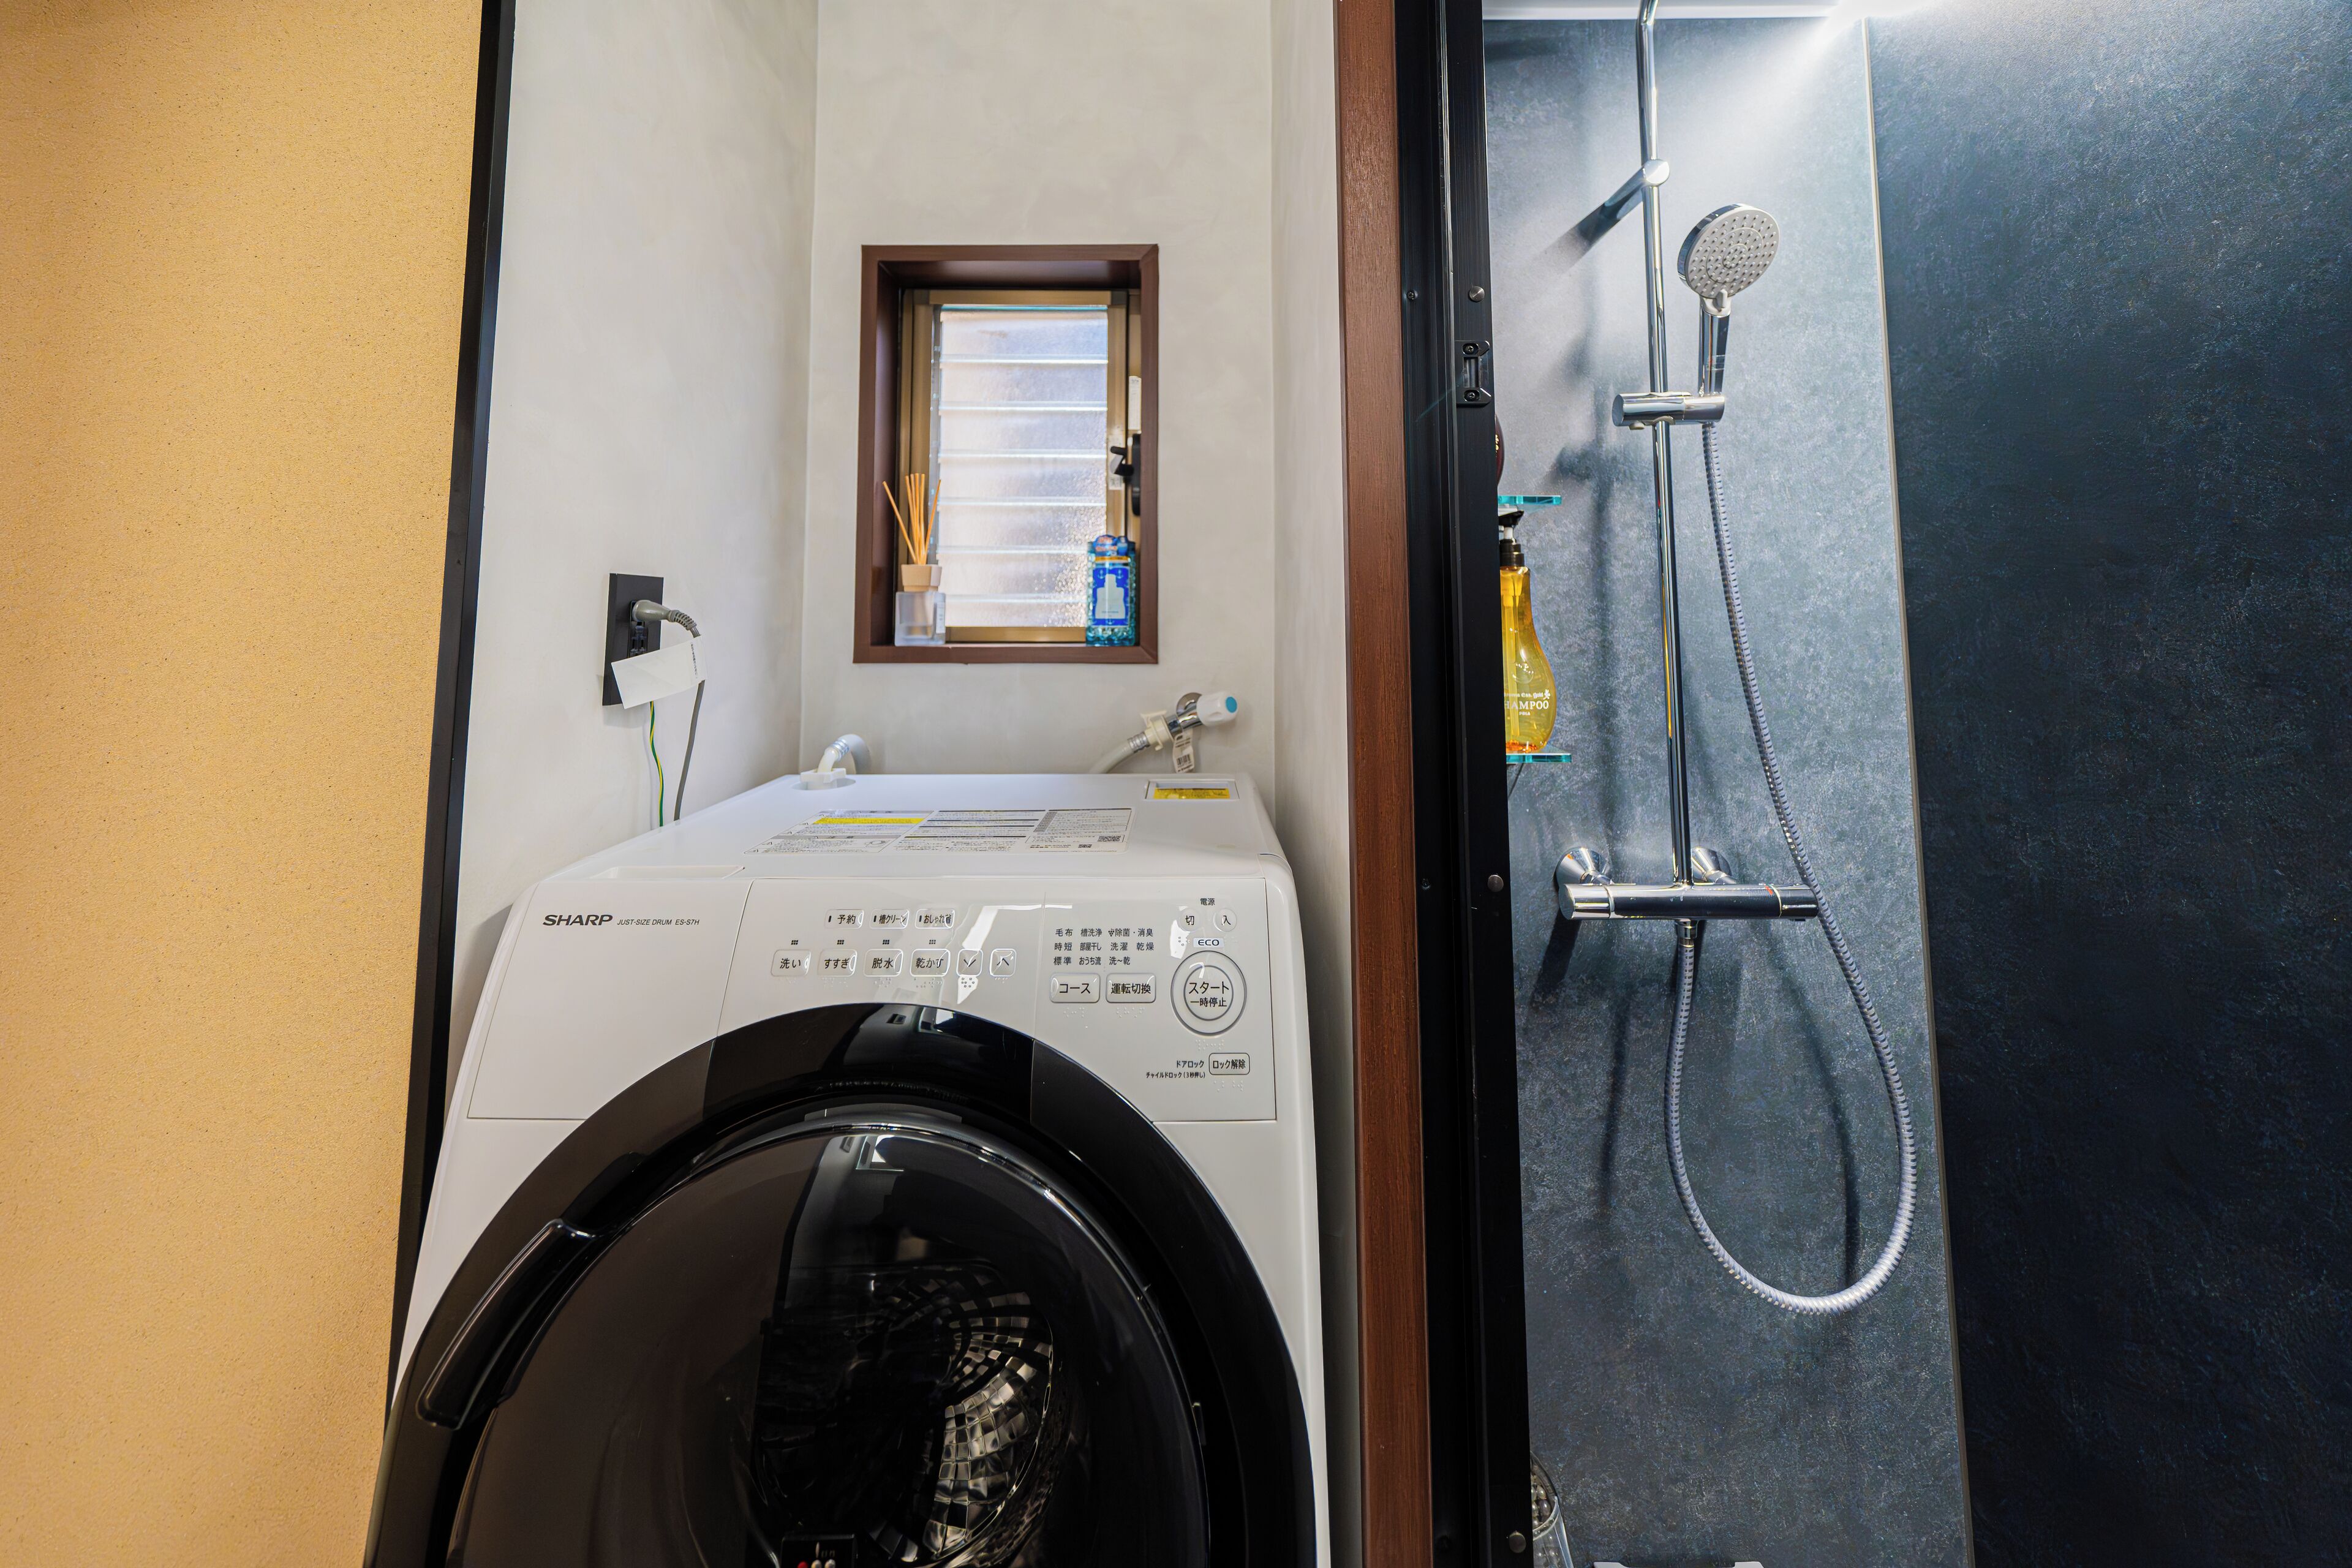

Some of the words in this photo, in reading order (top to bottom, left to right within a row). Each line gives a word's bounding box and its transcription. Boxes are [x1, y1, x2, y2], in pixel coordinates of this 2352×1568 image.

[1504, 701, 1549, 710] HAMPOO
[543, 914, 612, 926] SHARP
[837, 914, 856, 924] 予約
[879, 914, 906, 924] 槽クリーン
[1185, 915, 1195, 925] 切
[1221, 915, 1231, 925] 入
[1055, 928, 1073, 937] 毛布
[1081, 928, 1102, 937] 槽洗浄
[1054, 942, 1072, 951] 時短
[1080, 942, 1102, 951] 部屋干し
[1110, 942, 1128, 951] 洗濯
[1136, 942, 1154, 951] 乾燥
[780, 958, 801, 969] 洗い
[824, 958, 850, 969] すすぎ
[872, 957, 894, 969] 脱水
[916, 957, 944, 969] 乾かす
[1054, 956, 1072, 965] 標準
[1079, 956, 1101, 965] おうち流
[1059, 983, 1091, 994] コース
[1110, 983, 1151, 994] 運転切換
[1189, 981, 1229, 994] スタート
[1190, 997, 1227, 1008] 一時停止
[1213, 1059, 1246, 1069] ロック解除
